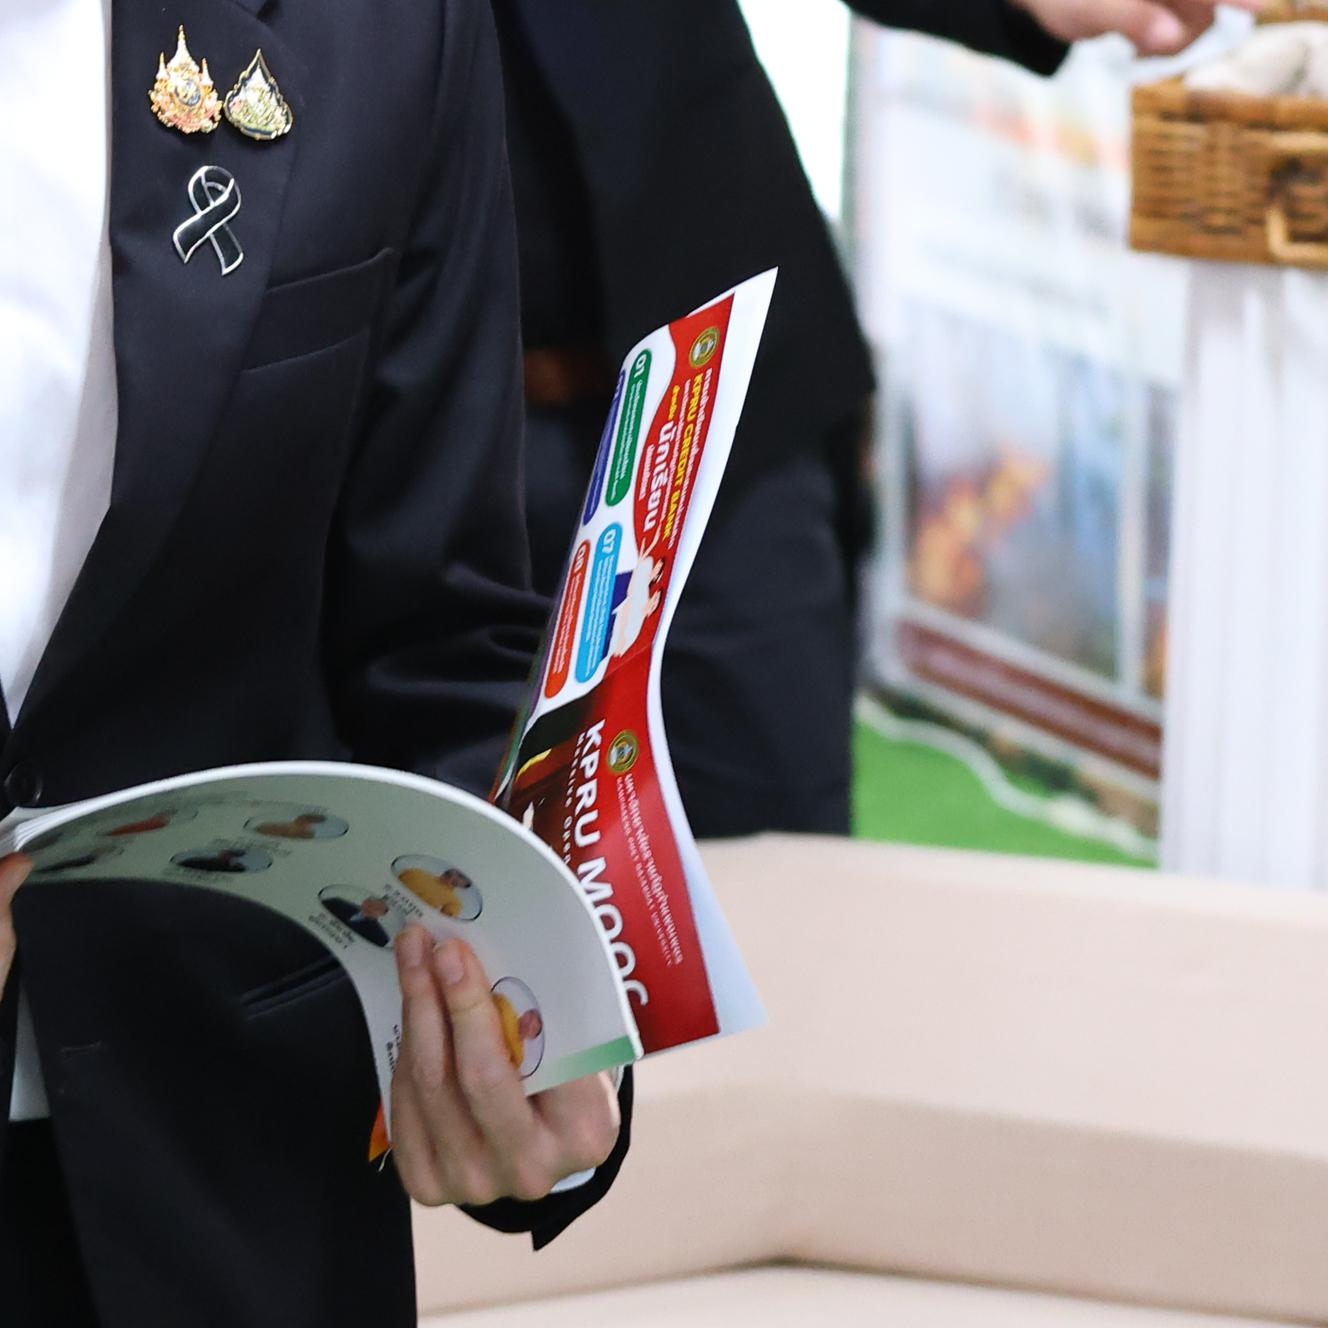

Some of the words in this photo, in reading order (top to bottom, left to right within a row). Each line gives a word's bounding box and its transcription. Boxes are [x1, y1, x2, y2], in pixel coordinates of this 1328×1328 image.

[687, 373, 704, 421] KPRU
[643, 420, 677, 532] นักเรียน
[675, 423, 694, 487] CREDIT
[602, 528, 617, 554] 07
[662, 488, 682, 542] BANK
[574, 719, 606, 849] KPRU
